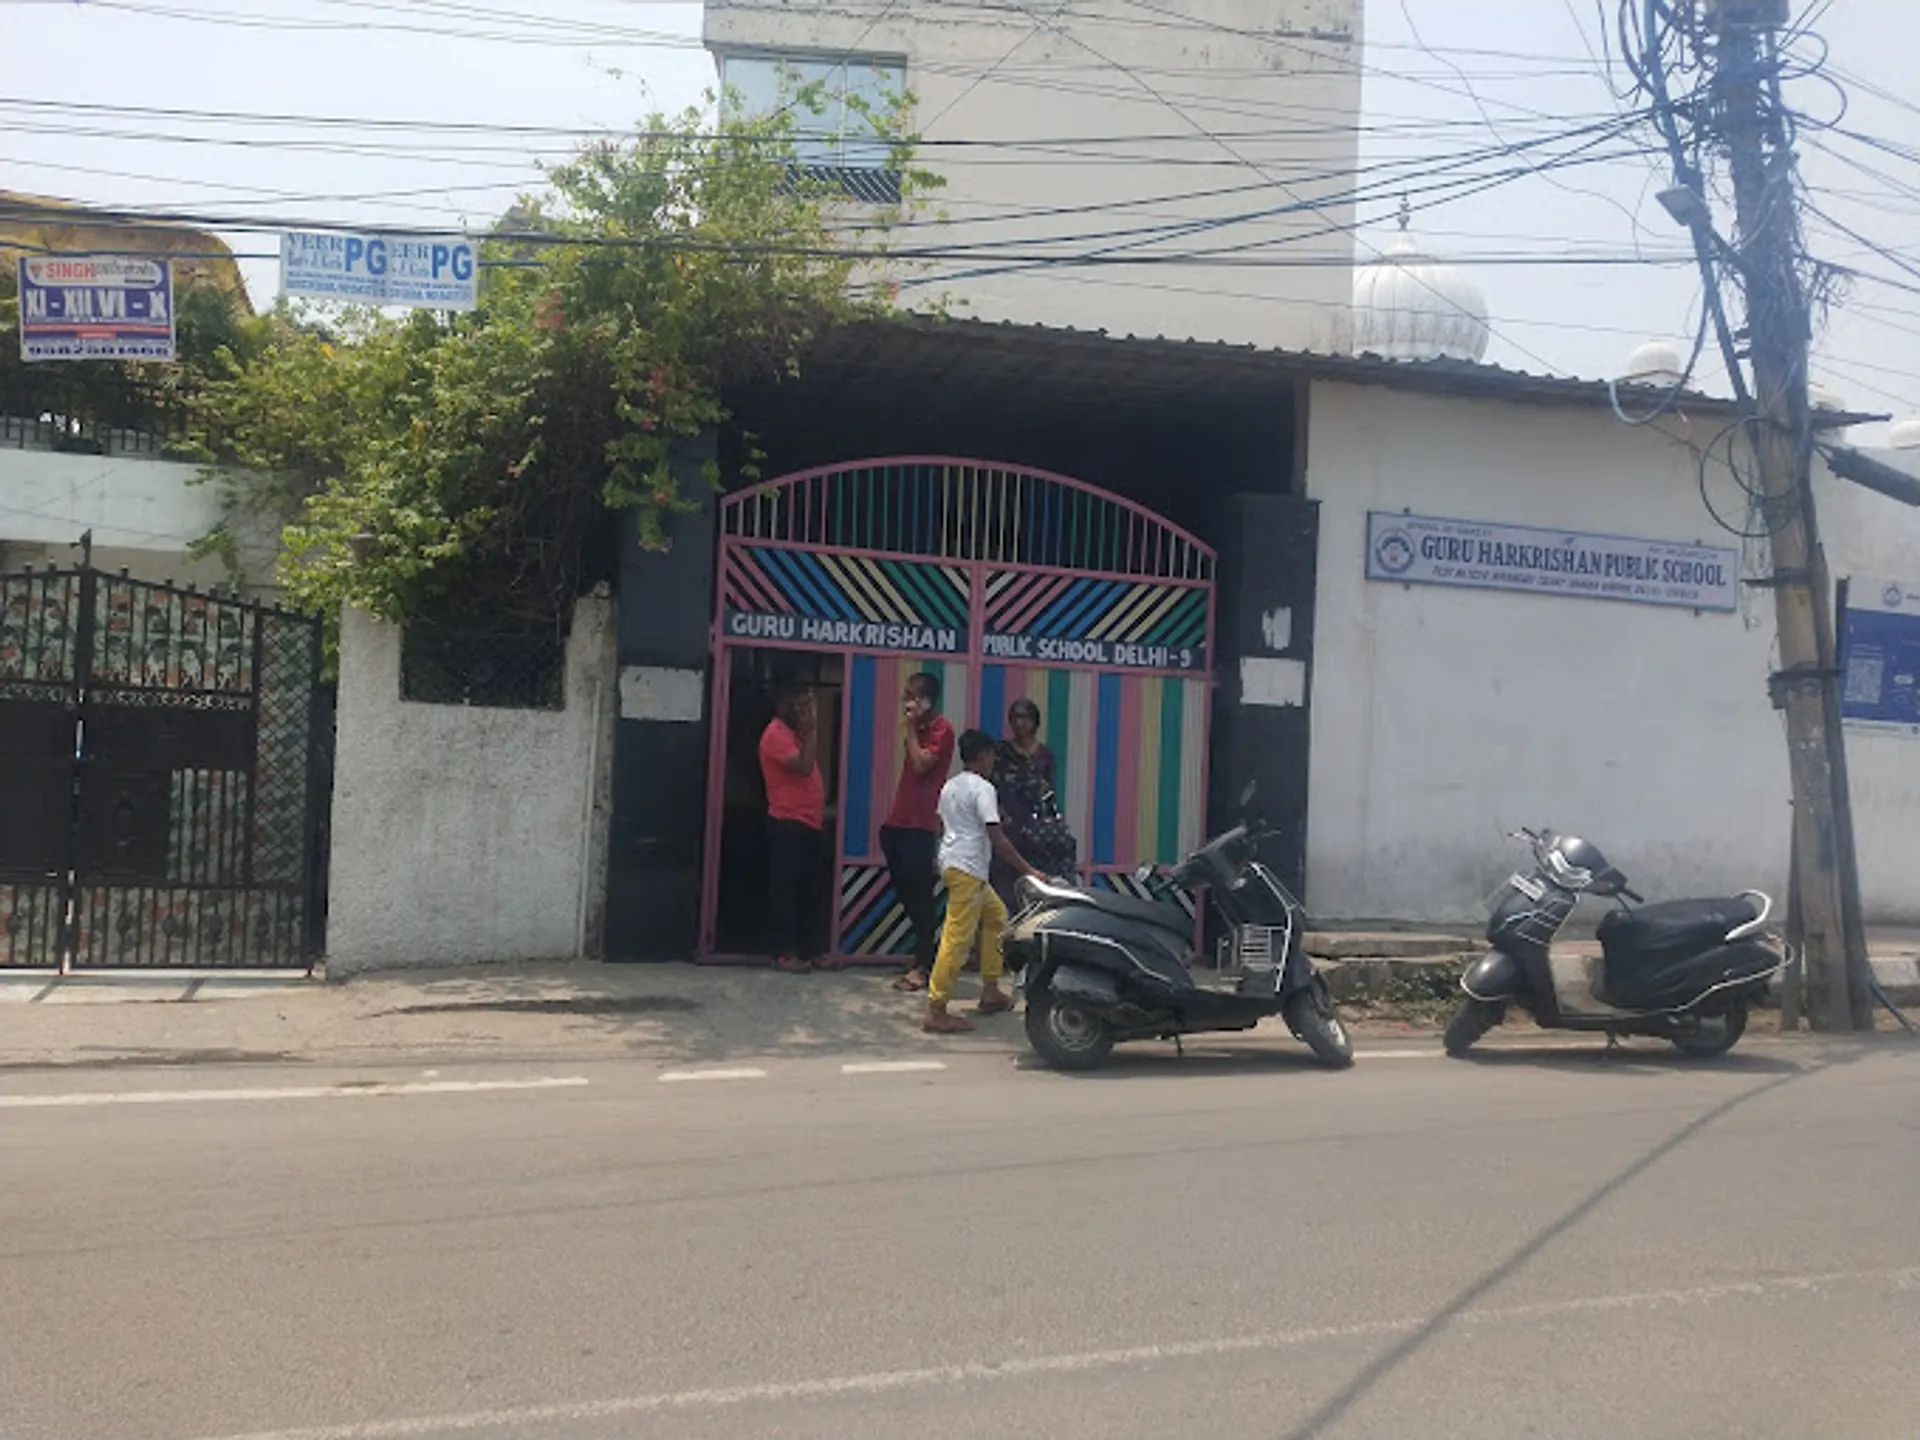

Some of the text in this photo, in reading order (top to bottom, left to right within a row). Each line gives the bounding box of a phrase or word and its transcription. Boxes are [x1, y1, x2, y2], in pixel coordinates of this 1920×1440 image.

[46, 262, 97, 279] SINGH
[345, 237, 388, 275] PG
[432, 244, 473, 281] PG
[1420, 536, 1474, 564] GURU
[1477, 541, 1603, 575] HARKRISHAN
[1604, 553, 1658, 581] PUBLIC
[1662, 559, 1727, 587] SCHOOL
[731, 613, 1192, 668] GURU HARKRISHAN PUBLIC SCHOOL DELHI-9
